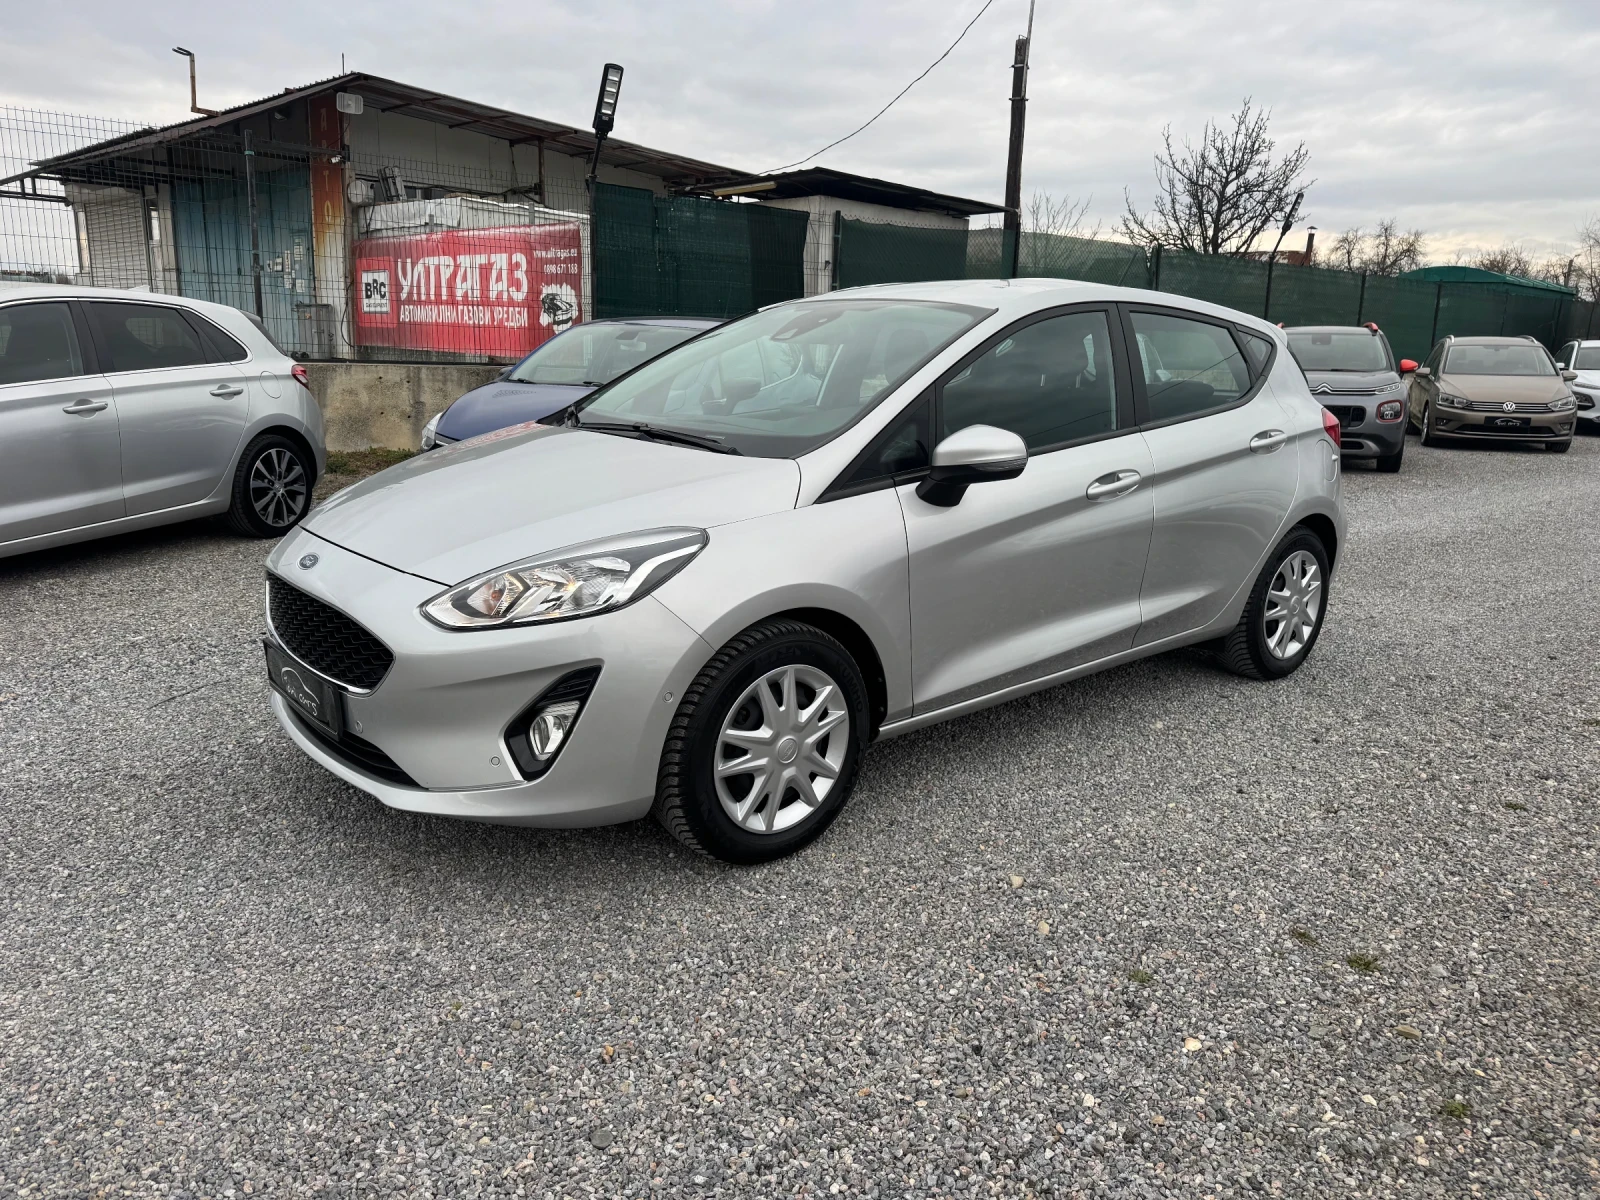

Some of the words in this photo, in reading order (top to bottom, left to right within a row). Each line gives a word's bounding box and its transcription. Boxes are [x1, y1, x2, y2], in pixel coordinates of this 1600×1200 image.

[397, 253, 528, 302] УЛТРАГАЗ
[365, 278, 386, 299] BRC
[458, 305, 492, 325] ГАЗОВИ
